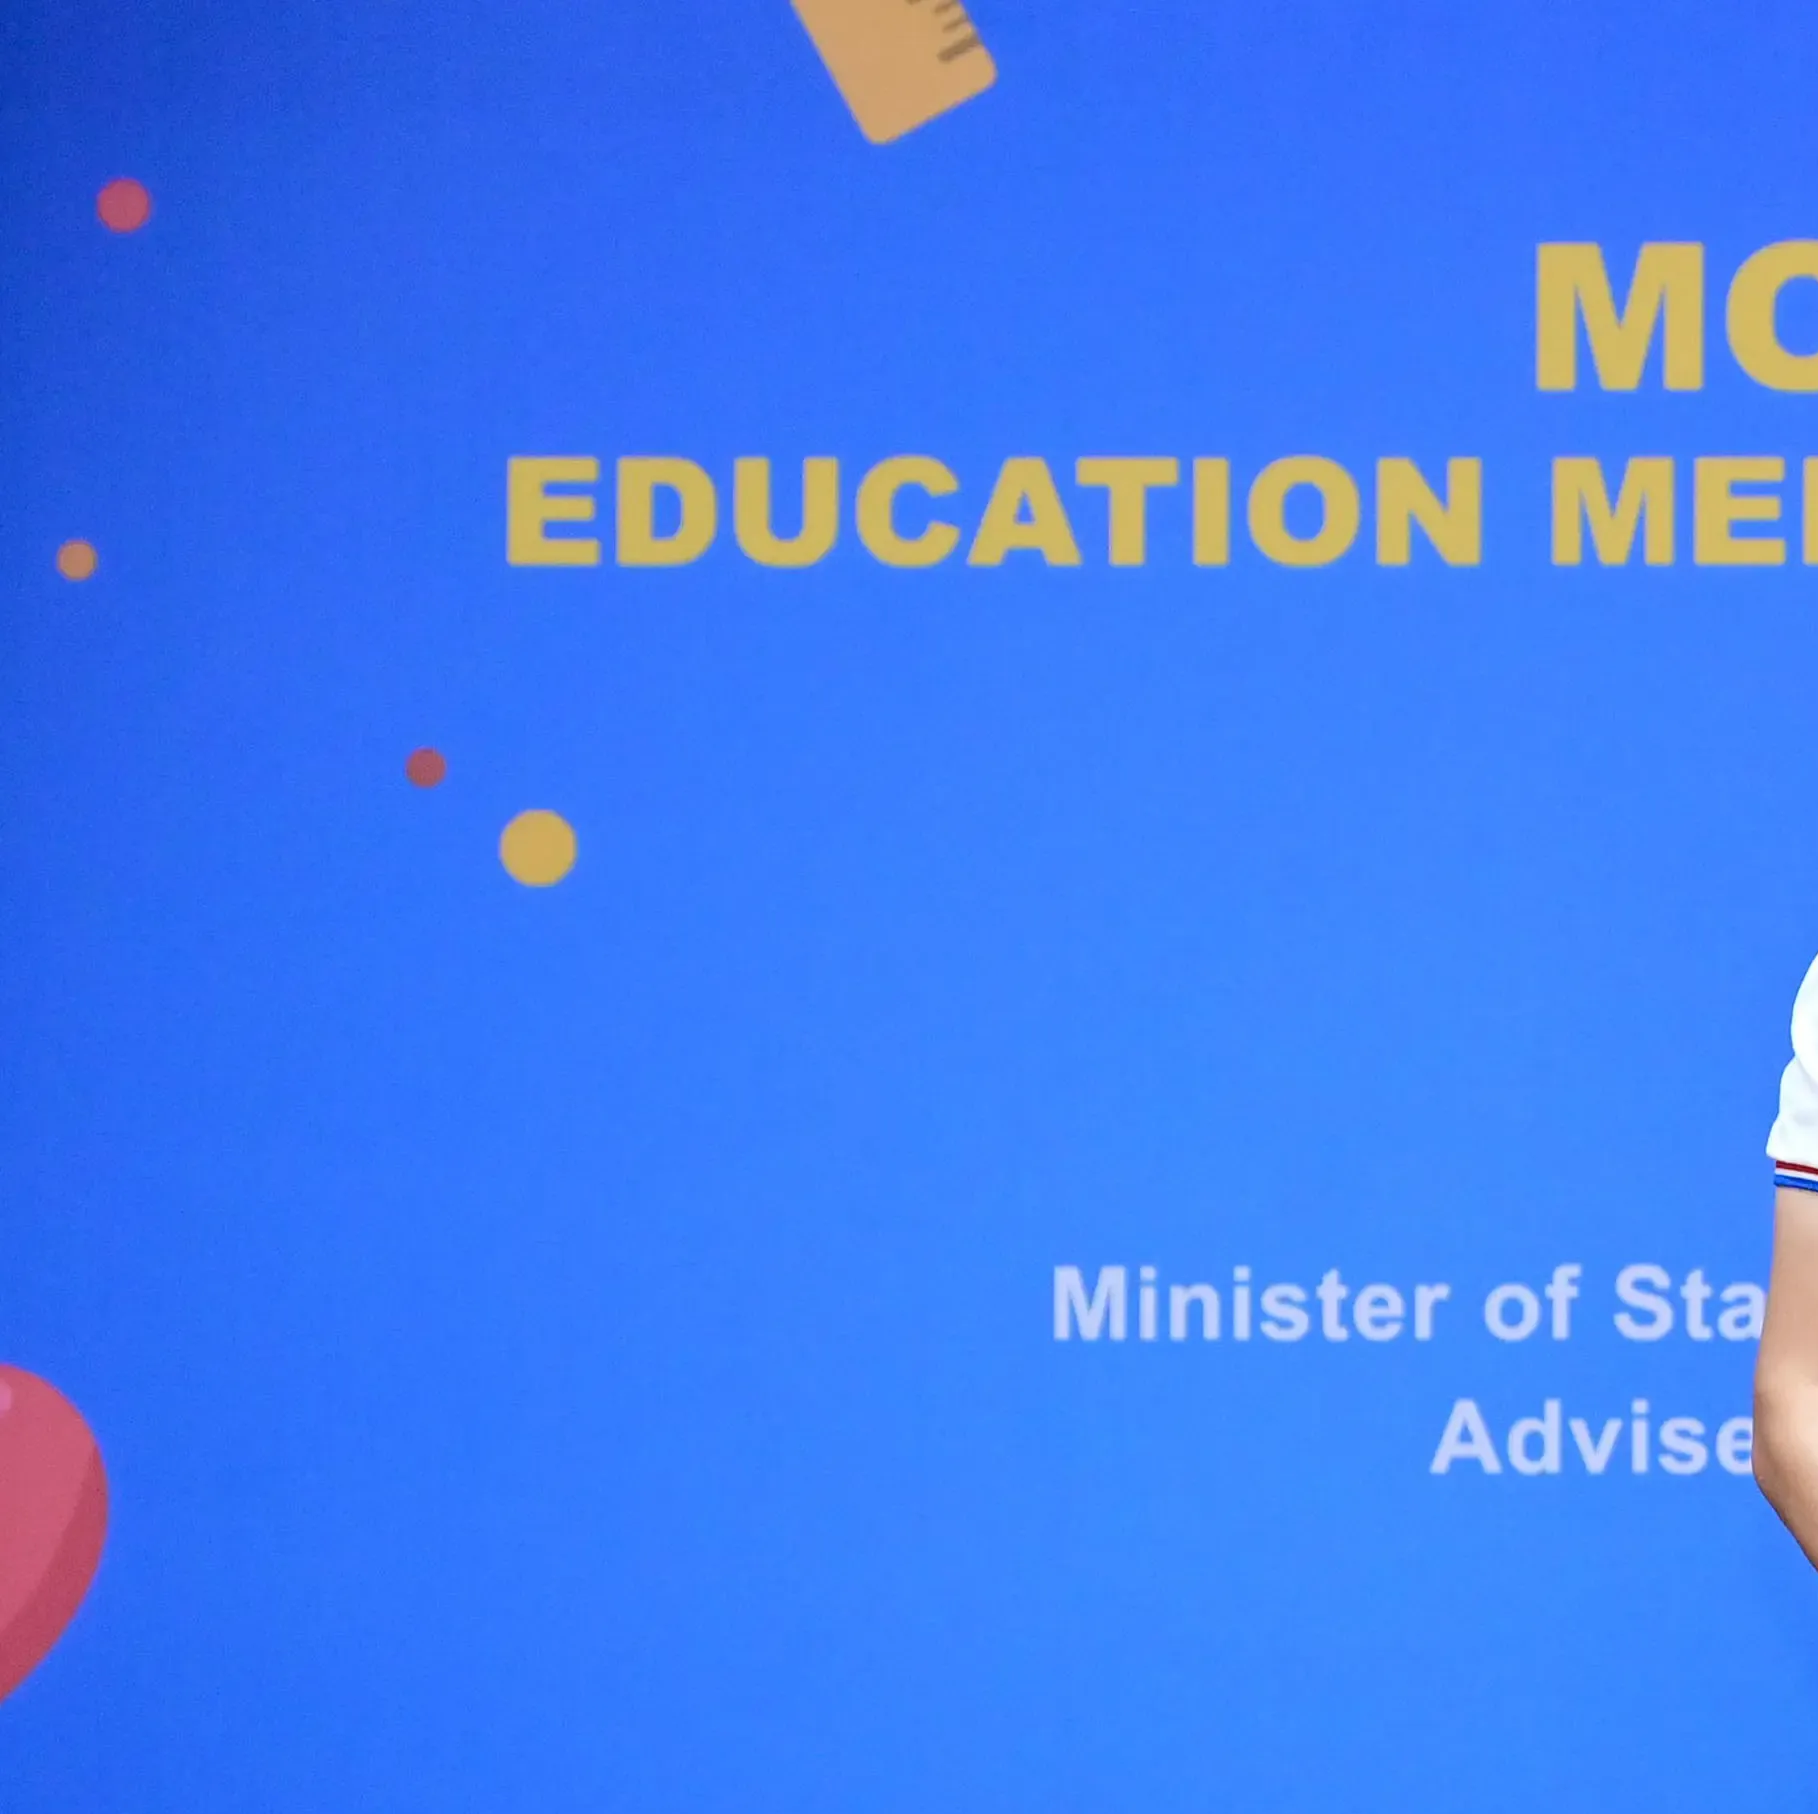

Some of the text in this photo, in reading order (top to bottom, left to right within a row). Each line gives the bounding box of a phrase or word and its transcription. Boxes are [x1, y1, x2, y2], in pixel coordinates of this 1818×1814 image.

[506, 454, 1482, 567] EDUCATION
[1052, 1265, 1450, 1342] Minister
[1483, 1263, 1582, 1342] of
[1613, 1263, 1766, 1342] Sta
[1429, 1399, 1753, 1476] Advise
